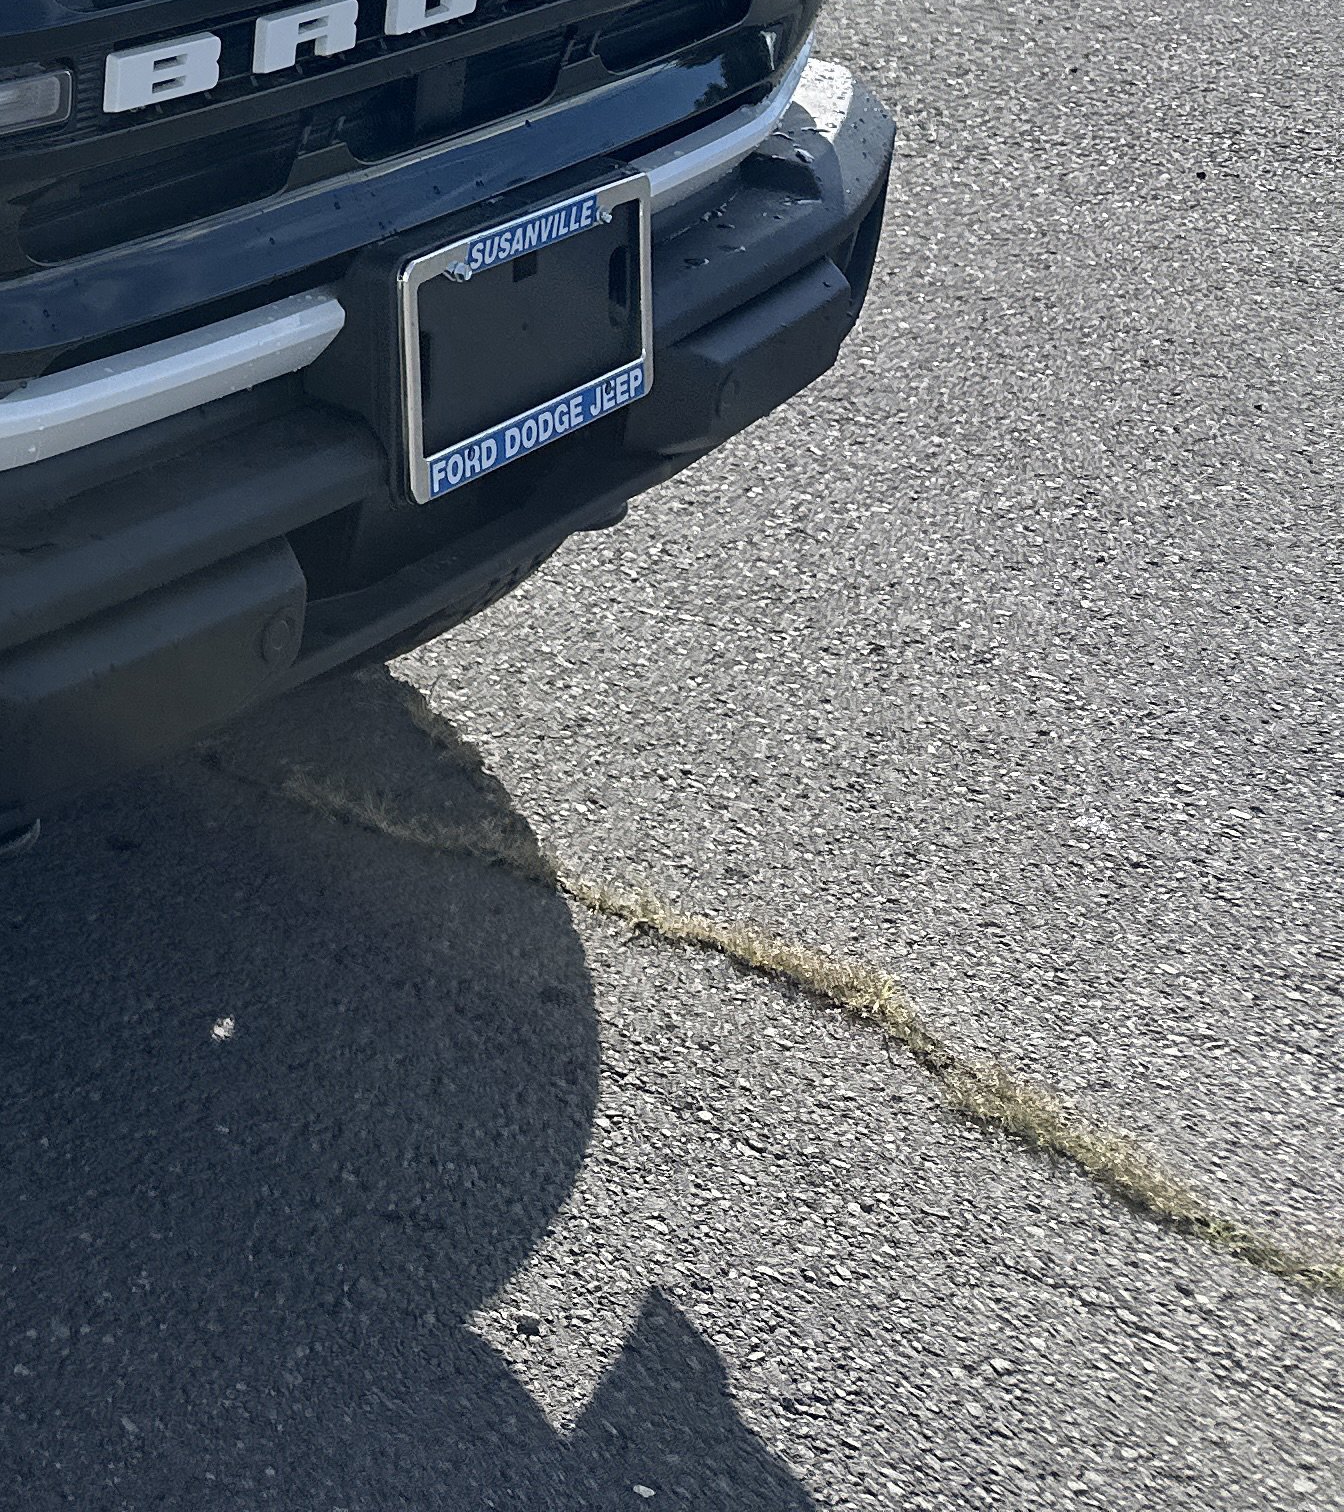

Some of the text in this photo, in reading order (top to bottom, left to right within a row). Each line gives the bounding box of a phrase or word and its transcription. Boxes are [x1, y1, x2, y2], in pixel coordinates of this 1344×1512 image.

[469, 198, 595, 270] SUSANVILLE
[431, 367, 644, 494] FORD DODGE JEEP
